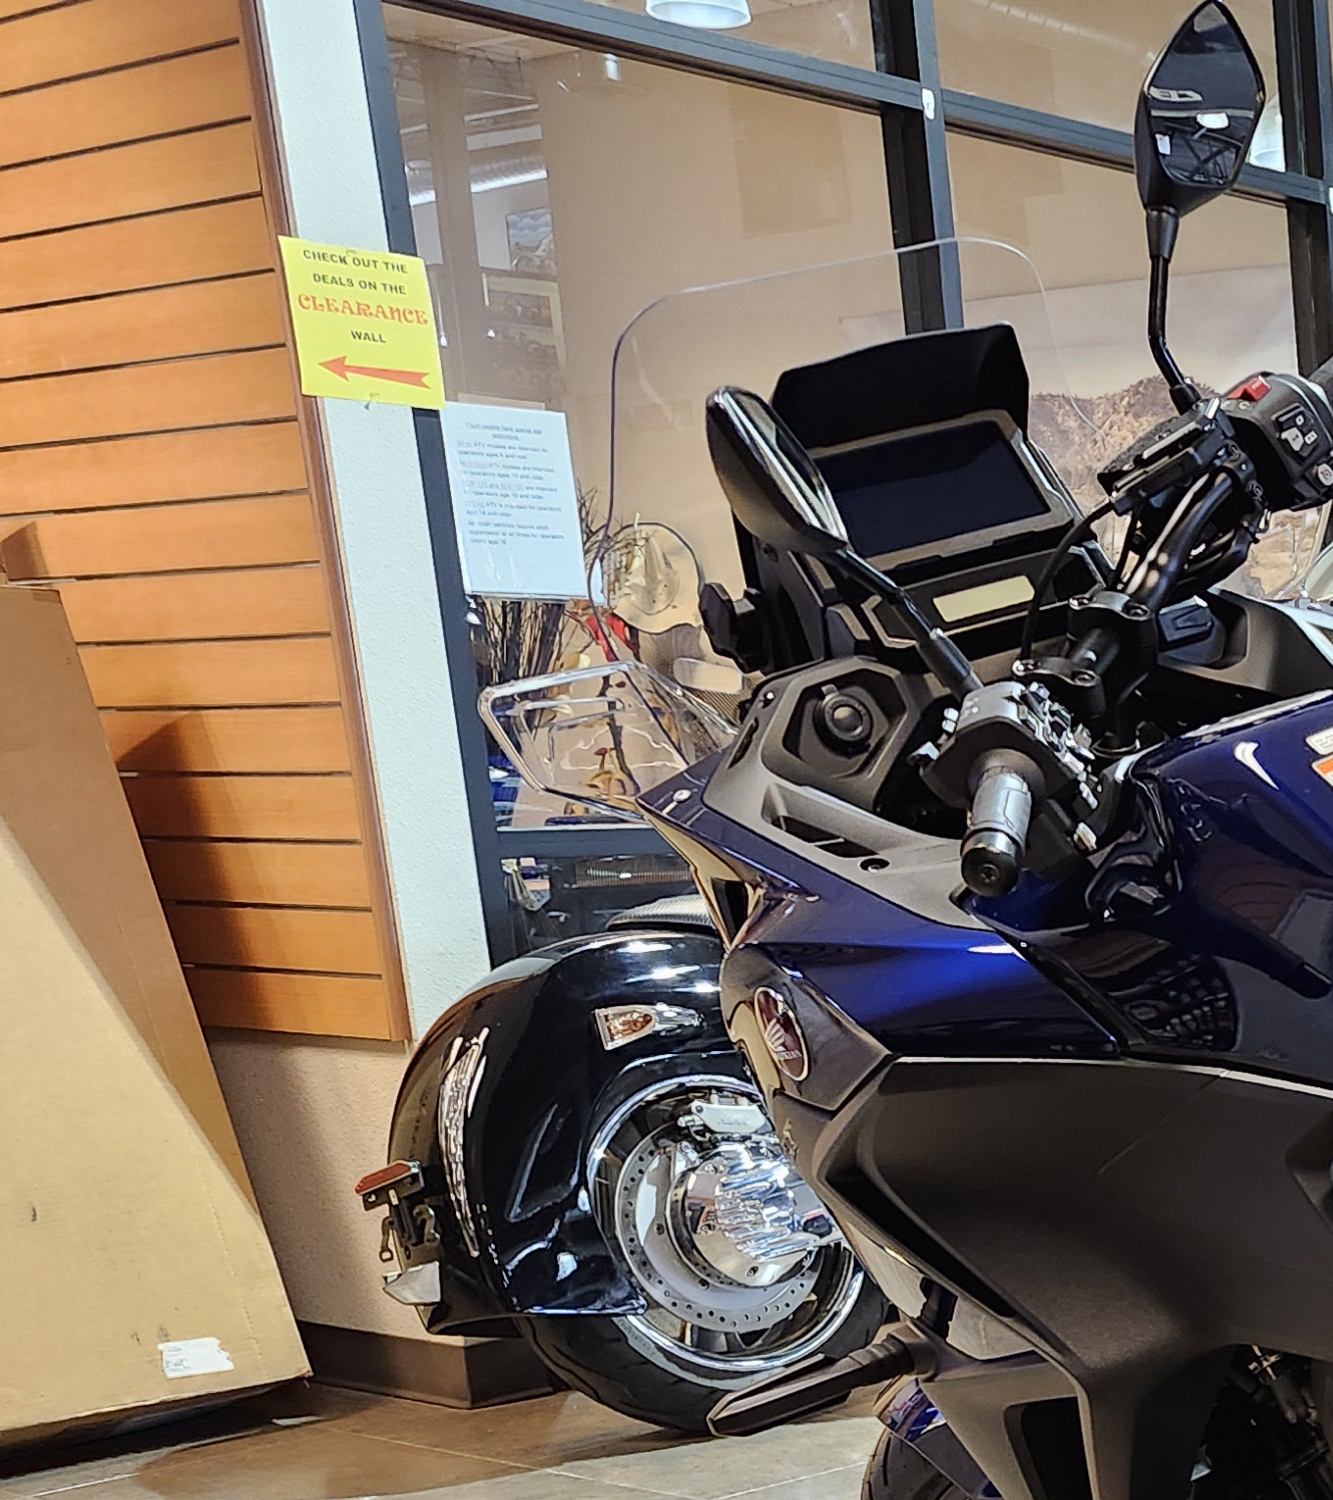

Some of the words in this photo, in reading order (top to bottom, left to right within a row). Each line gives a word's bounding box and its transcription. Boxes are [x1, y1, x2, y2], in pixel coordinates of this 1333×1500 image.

[303, 249, 348, 266] CHECK
[352, 256, 379, 269] OUT
[382, 261, 408, 274] THE
[313, 273, 354, 288] DEALS
[358, 280, 377, 291] ON
[381, 283, 406, 295] THE
[298, 293, 429, 325] CLEARANCE
[350, 329, 387, 344] WALL
